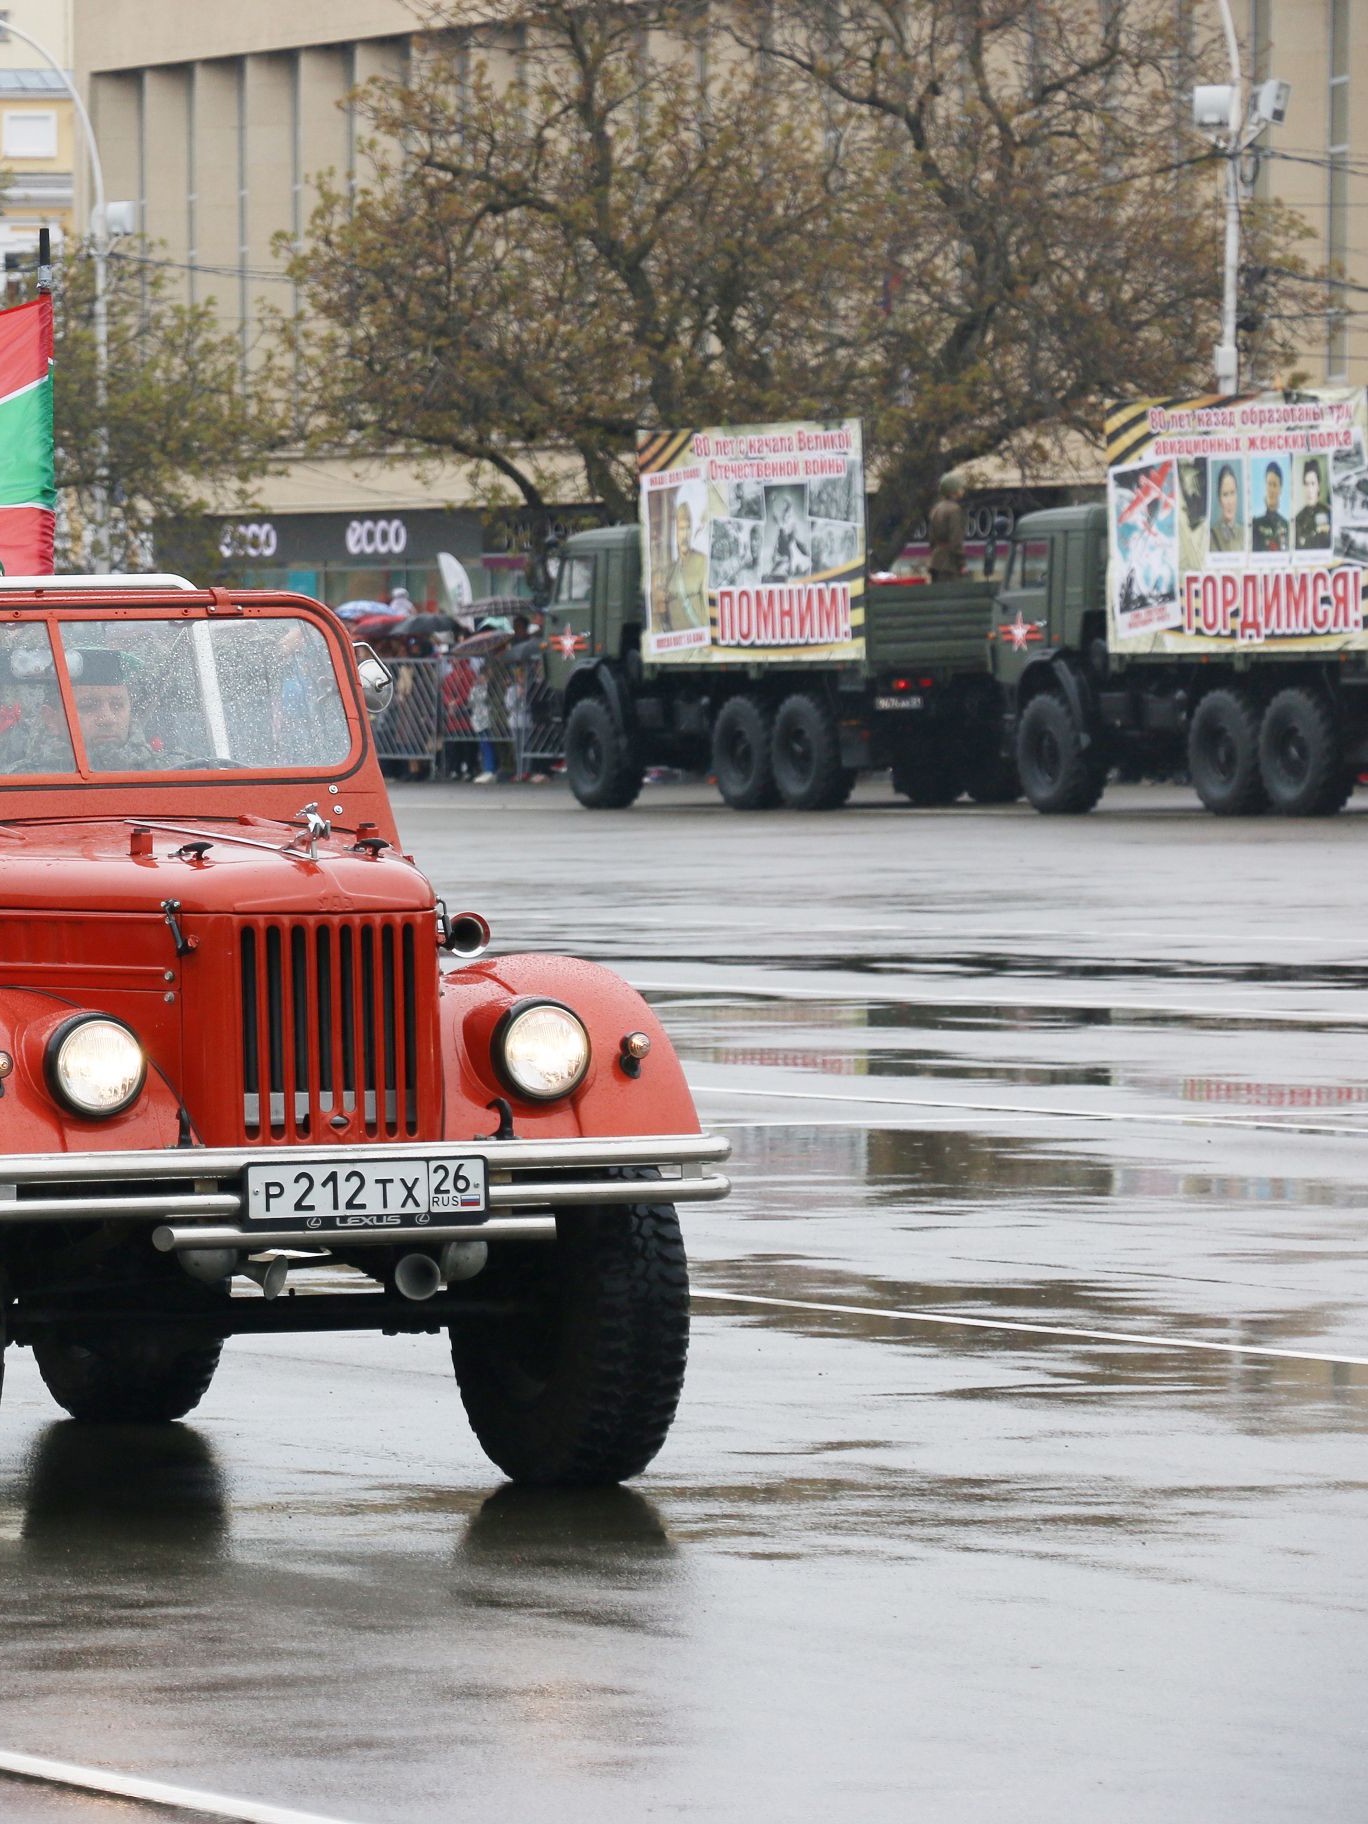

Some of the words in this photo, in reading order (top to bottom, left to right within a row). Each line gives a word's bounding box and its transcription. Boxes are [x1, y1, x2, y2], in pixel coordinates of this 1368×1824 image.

[1150, 409, 1166, 430] 80
[1170, 411, 1192, 429] лет
[1197, 409, 1236, 429] назад
[1241, 405, 1324, 428] образованы
[694, 435, 711, 457] 80
[715, 438, 735, 456] лет
[747, 435, 795, 455] начала
[797, 428, 852, 452] Великой
[1155, 434, 1241, 456] авиационных
[1247, 432, 1307, 451] женских
[1309, 430, 1353, 448] полка
[709, 458, 800, 481] Отечественной
[805, 457, 847, 476] войны
[345, 518, 408, 555] ecco
[719, 586, 852, 642] ПОМНИМ!
[1185, 570, 1362, 640] ГОРДИМСЯ!
[432, 1163, 471, 1195] 26
[431, 1195, 460, 1208] RUS
[335, 1214, 401, 1227] LEXUS
